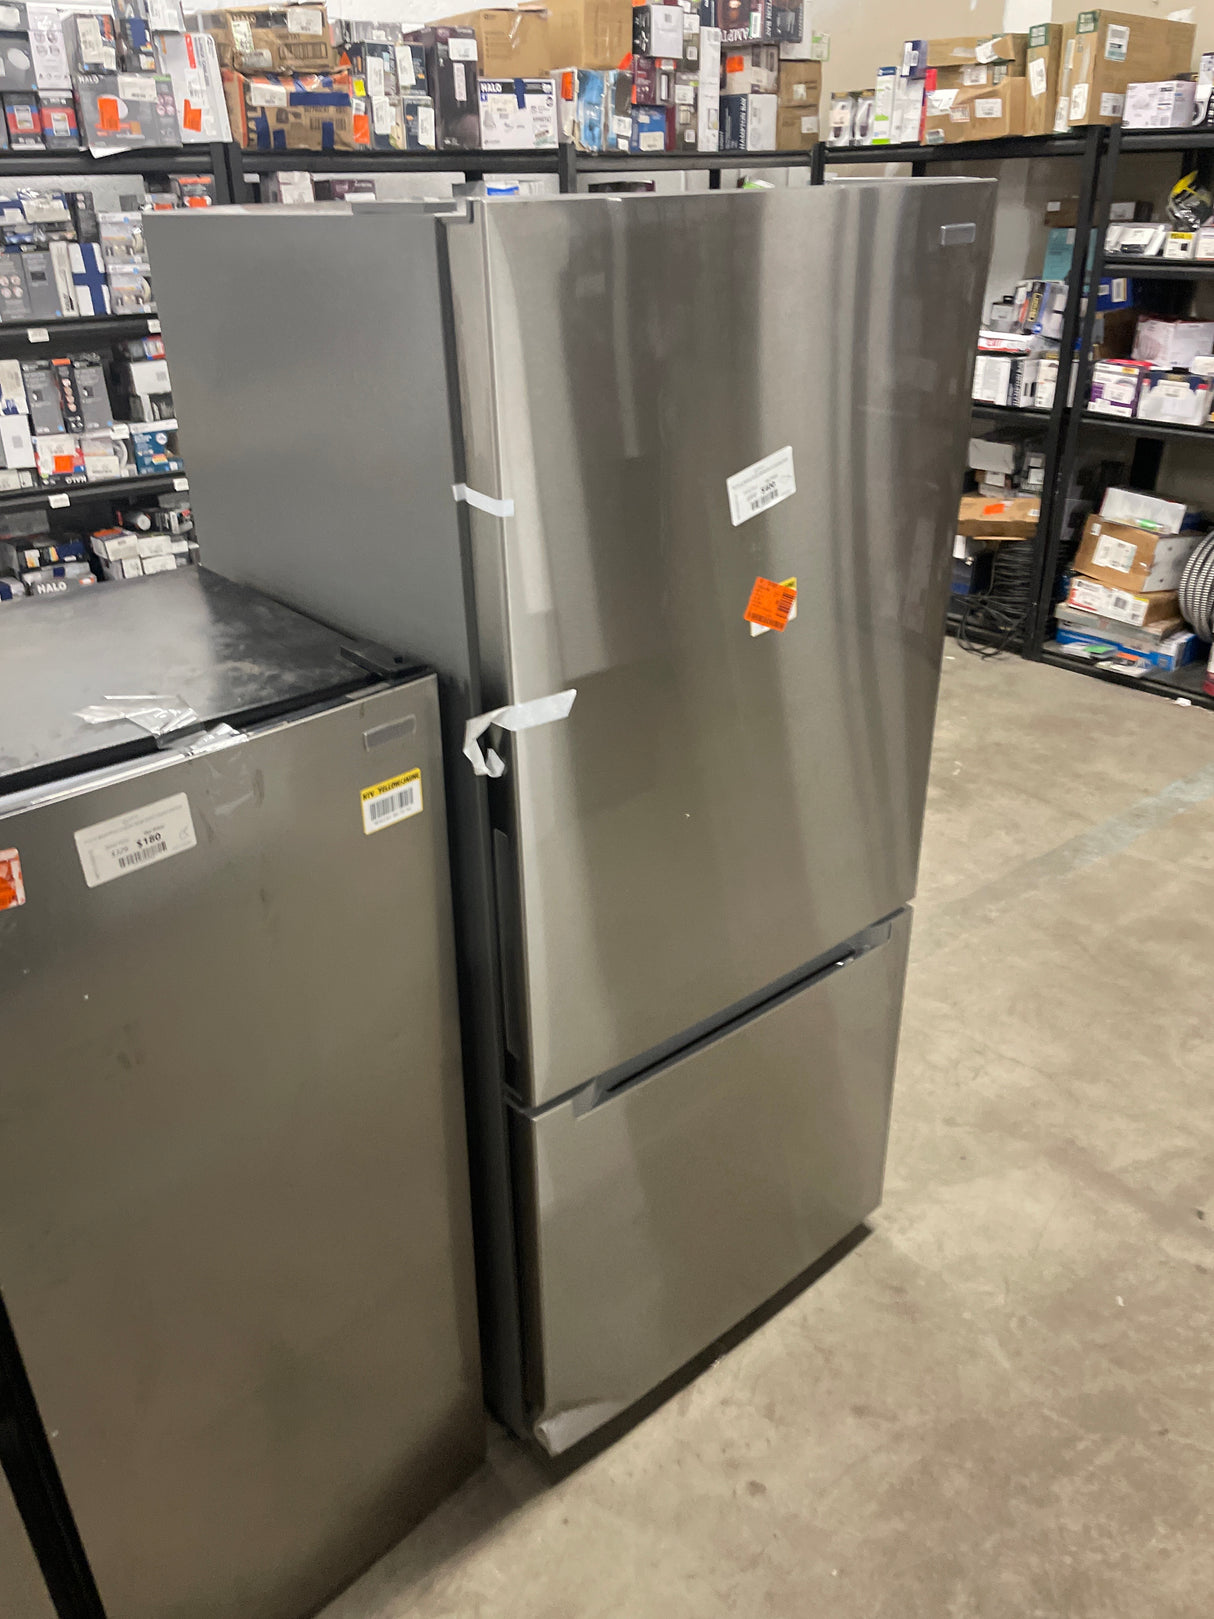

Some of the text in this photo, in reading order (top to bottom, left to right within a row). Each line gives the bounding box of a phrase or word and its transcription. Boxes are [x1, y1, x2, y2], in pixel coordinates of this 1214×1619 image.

[480, 82, 503, 93] HALO
[37, 581, 67, 595] HALO
[136, 832, 162, 848] $180
